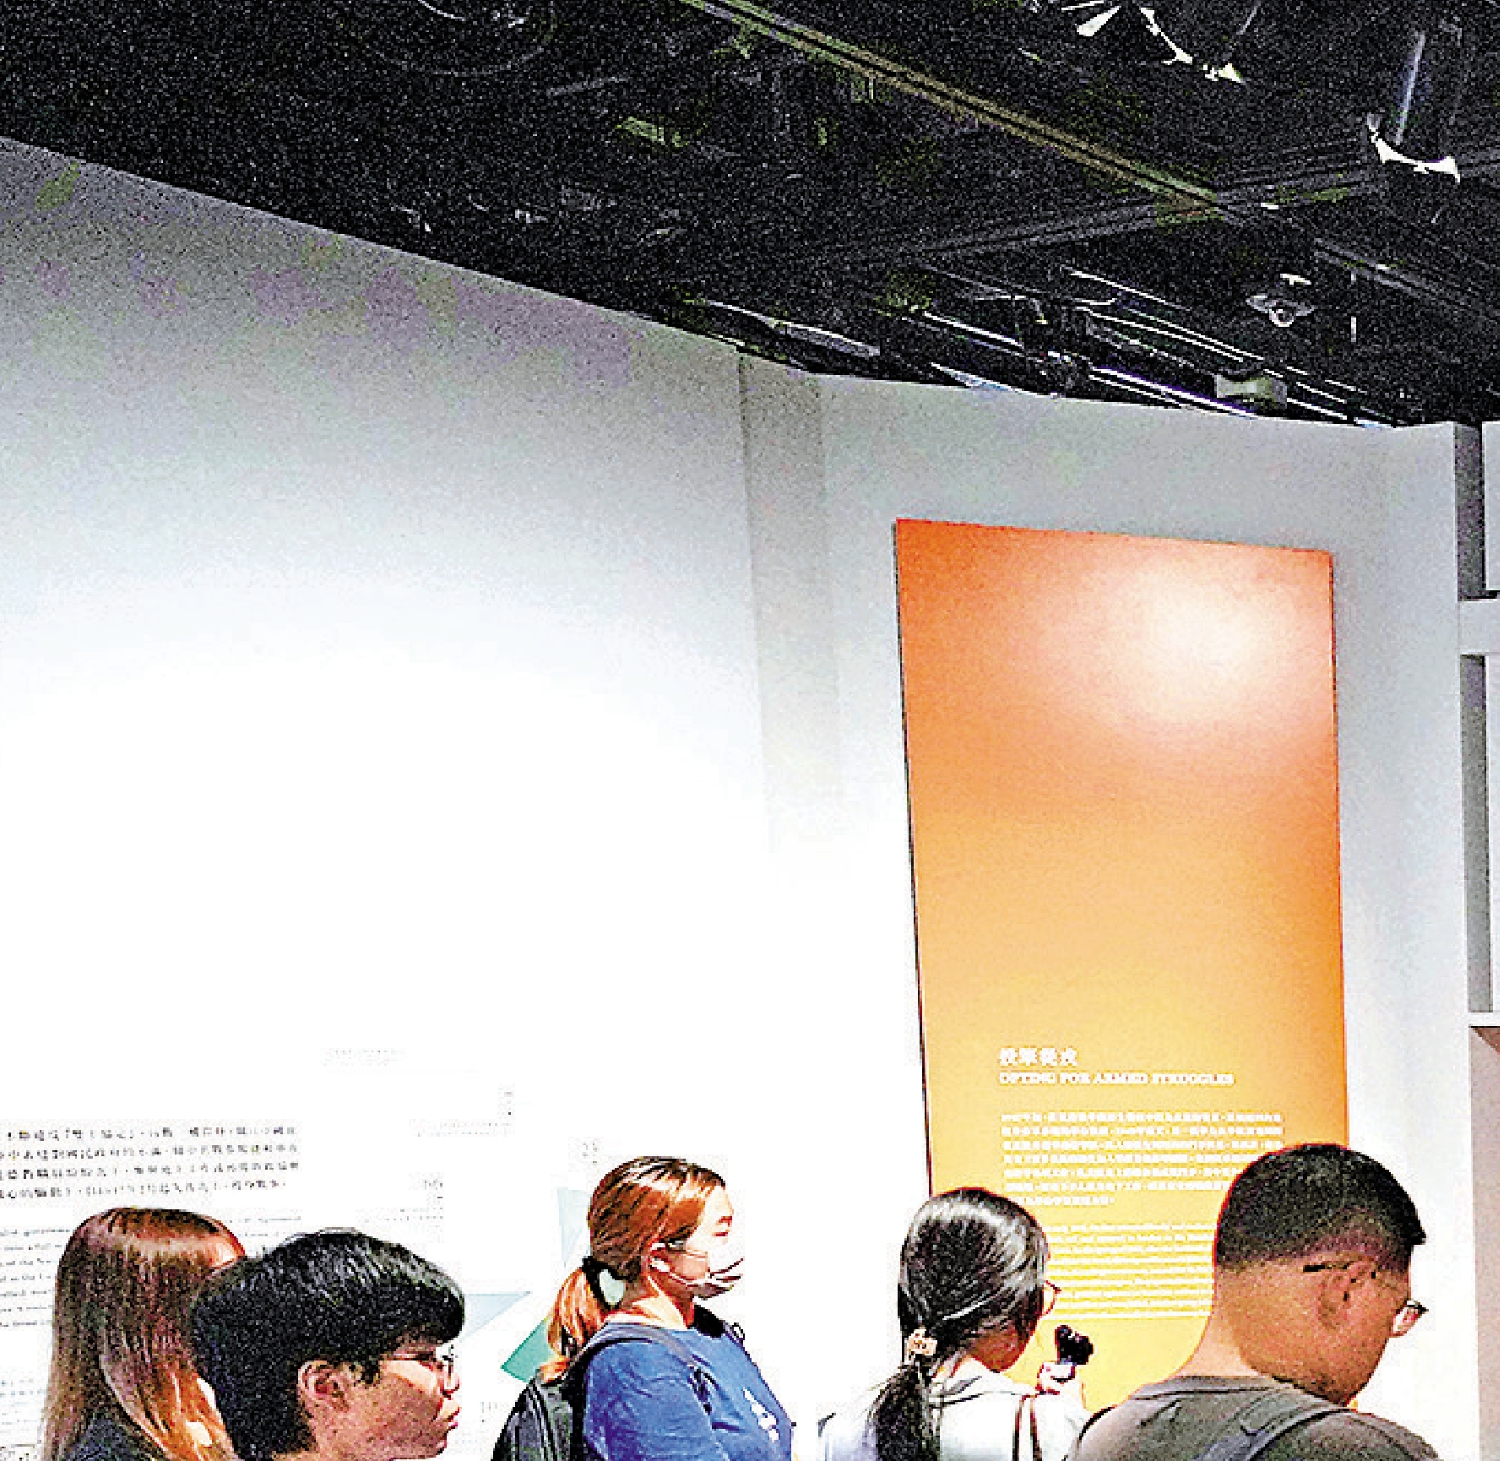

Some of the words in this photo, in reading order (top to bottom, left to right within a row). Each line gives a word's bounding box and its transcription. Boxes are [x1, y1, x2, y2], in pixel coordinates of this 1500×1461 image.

[999, 1072, 1056, 1085] OPTING
[1059, 1073, 1091, 1085] FOR
[1093, 1073, 1149, 1085] ARMED
